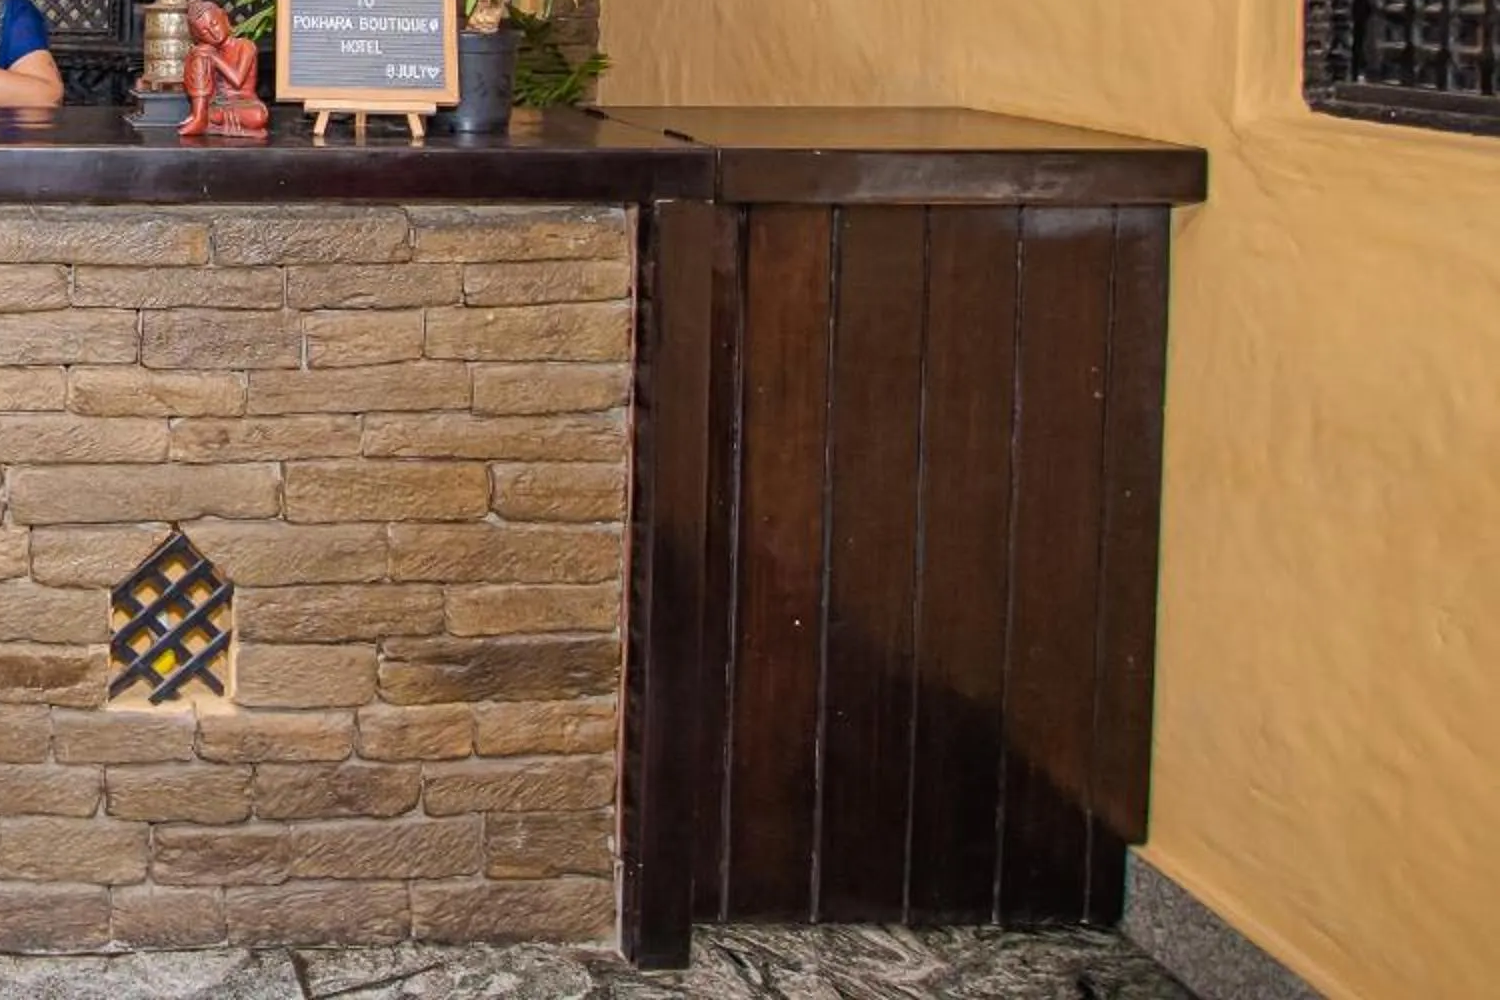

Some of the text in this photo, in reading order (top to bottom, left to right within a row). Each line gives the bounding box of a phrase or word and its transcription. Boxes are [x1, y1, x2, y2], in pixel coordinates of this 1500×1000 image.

[293, 15, 427, 32] POKHARA BOUTIQUE
[341, 39, 382, 54] HOTEL
